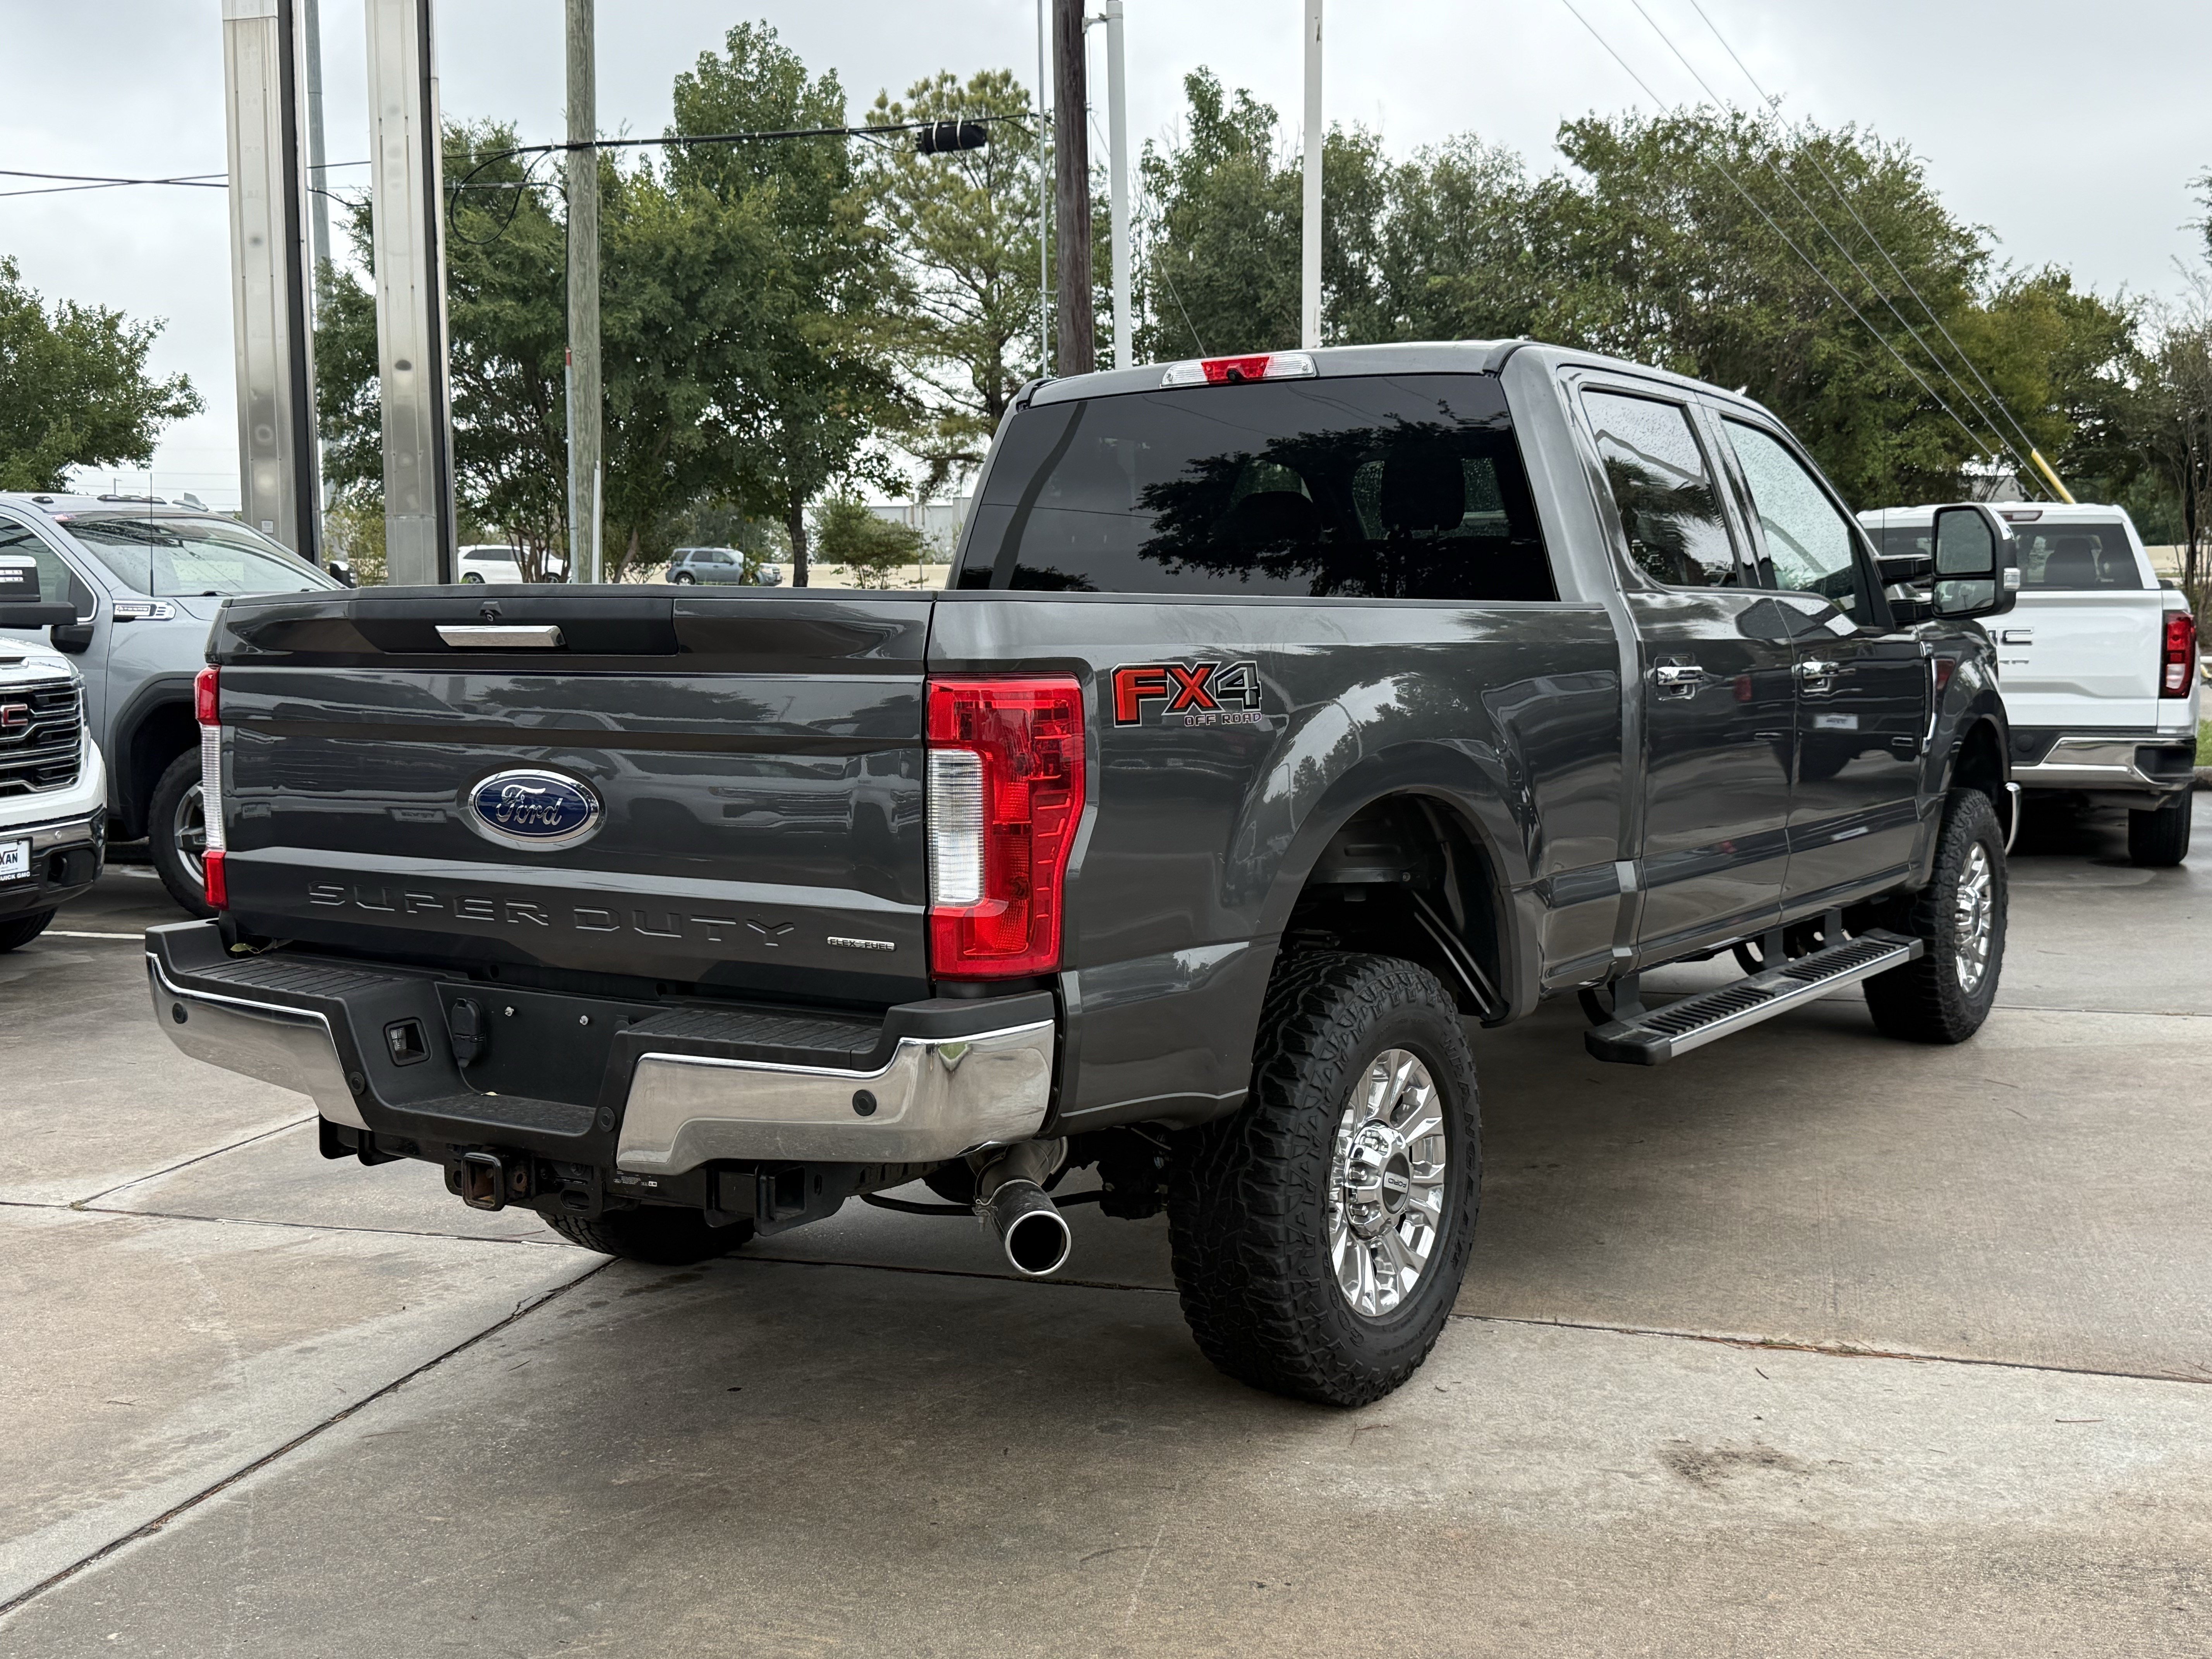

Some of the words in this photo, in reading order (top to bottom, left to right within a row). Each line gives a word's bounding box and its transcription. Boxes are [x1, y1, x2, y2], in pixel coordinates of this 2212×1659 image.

[1111, 660, 1262, 728] FX4
[1184, 714, 1216, 726] OFF
[1221, 713, 1262, 725] ROAD
[496, 785, 563, 826] Ford
[0, 848, 18, 866] XAN
[309, 881, 549, 926] SUPER
[574, 905, 795, 946] DUTY
[830, 938, 856, 947] FLEX
[864, 941, 894, 950] FUEL
[1388, 1178, 1407, 1188] FORD
